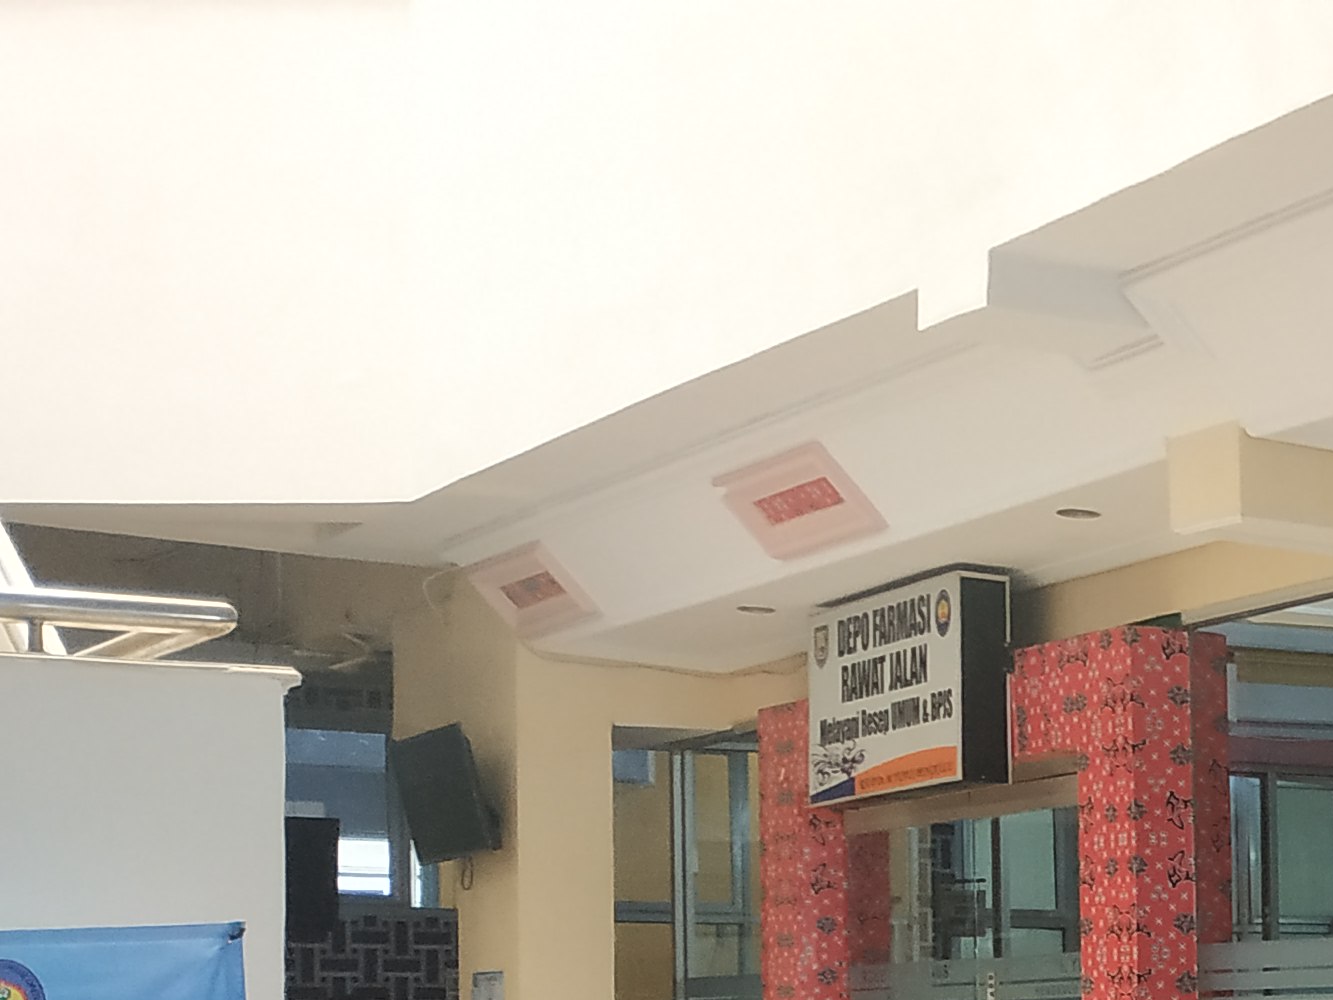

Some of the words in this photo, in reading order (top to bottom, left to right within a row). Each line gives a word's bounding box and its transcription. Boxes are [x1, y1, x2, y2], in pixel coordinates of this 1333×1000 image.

[838, 611, 869, 658] DEPO
[872, 594, 931, 648] FARMASI
[841, 655, 886, 703] RAWAT
[888, 643, 928, 691] JALAN
[931, 688, 953, 721] BPJS
